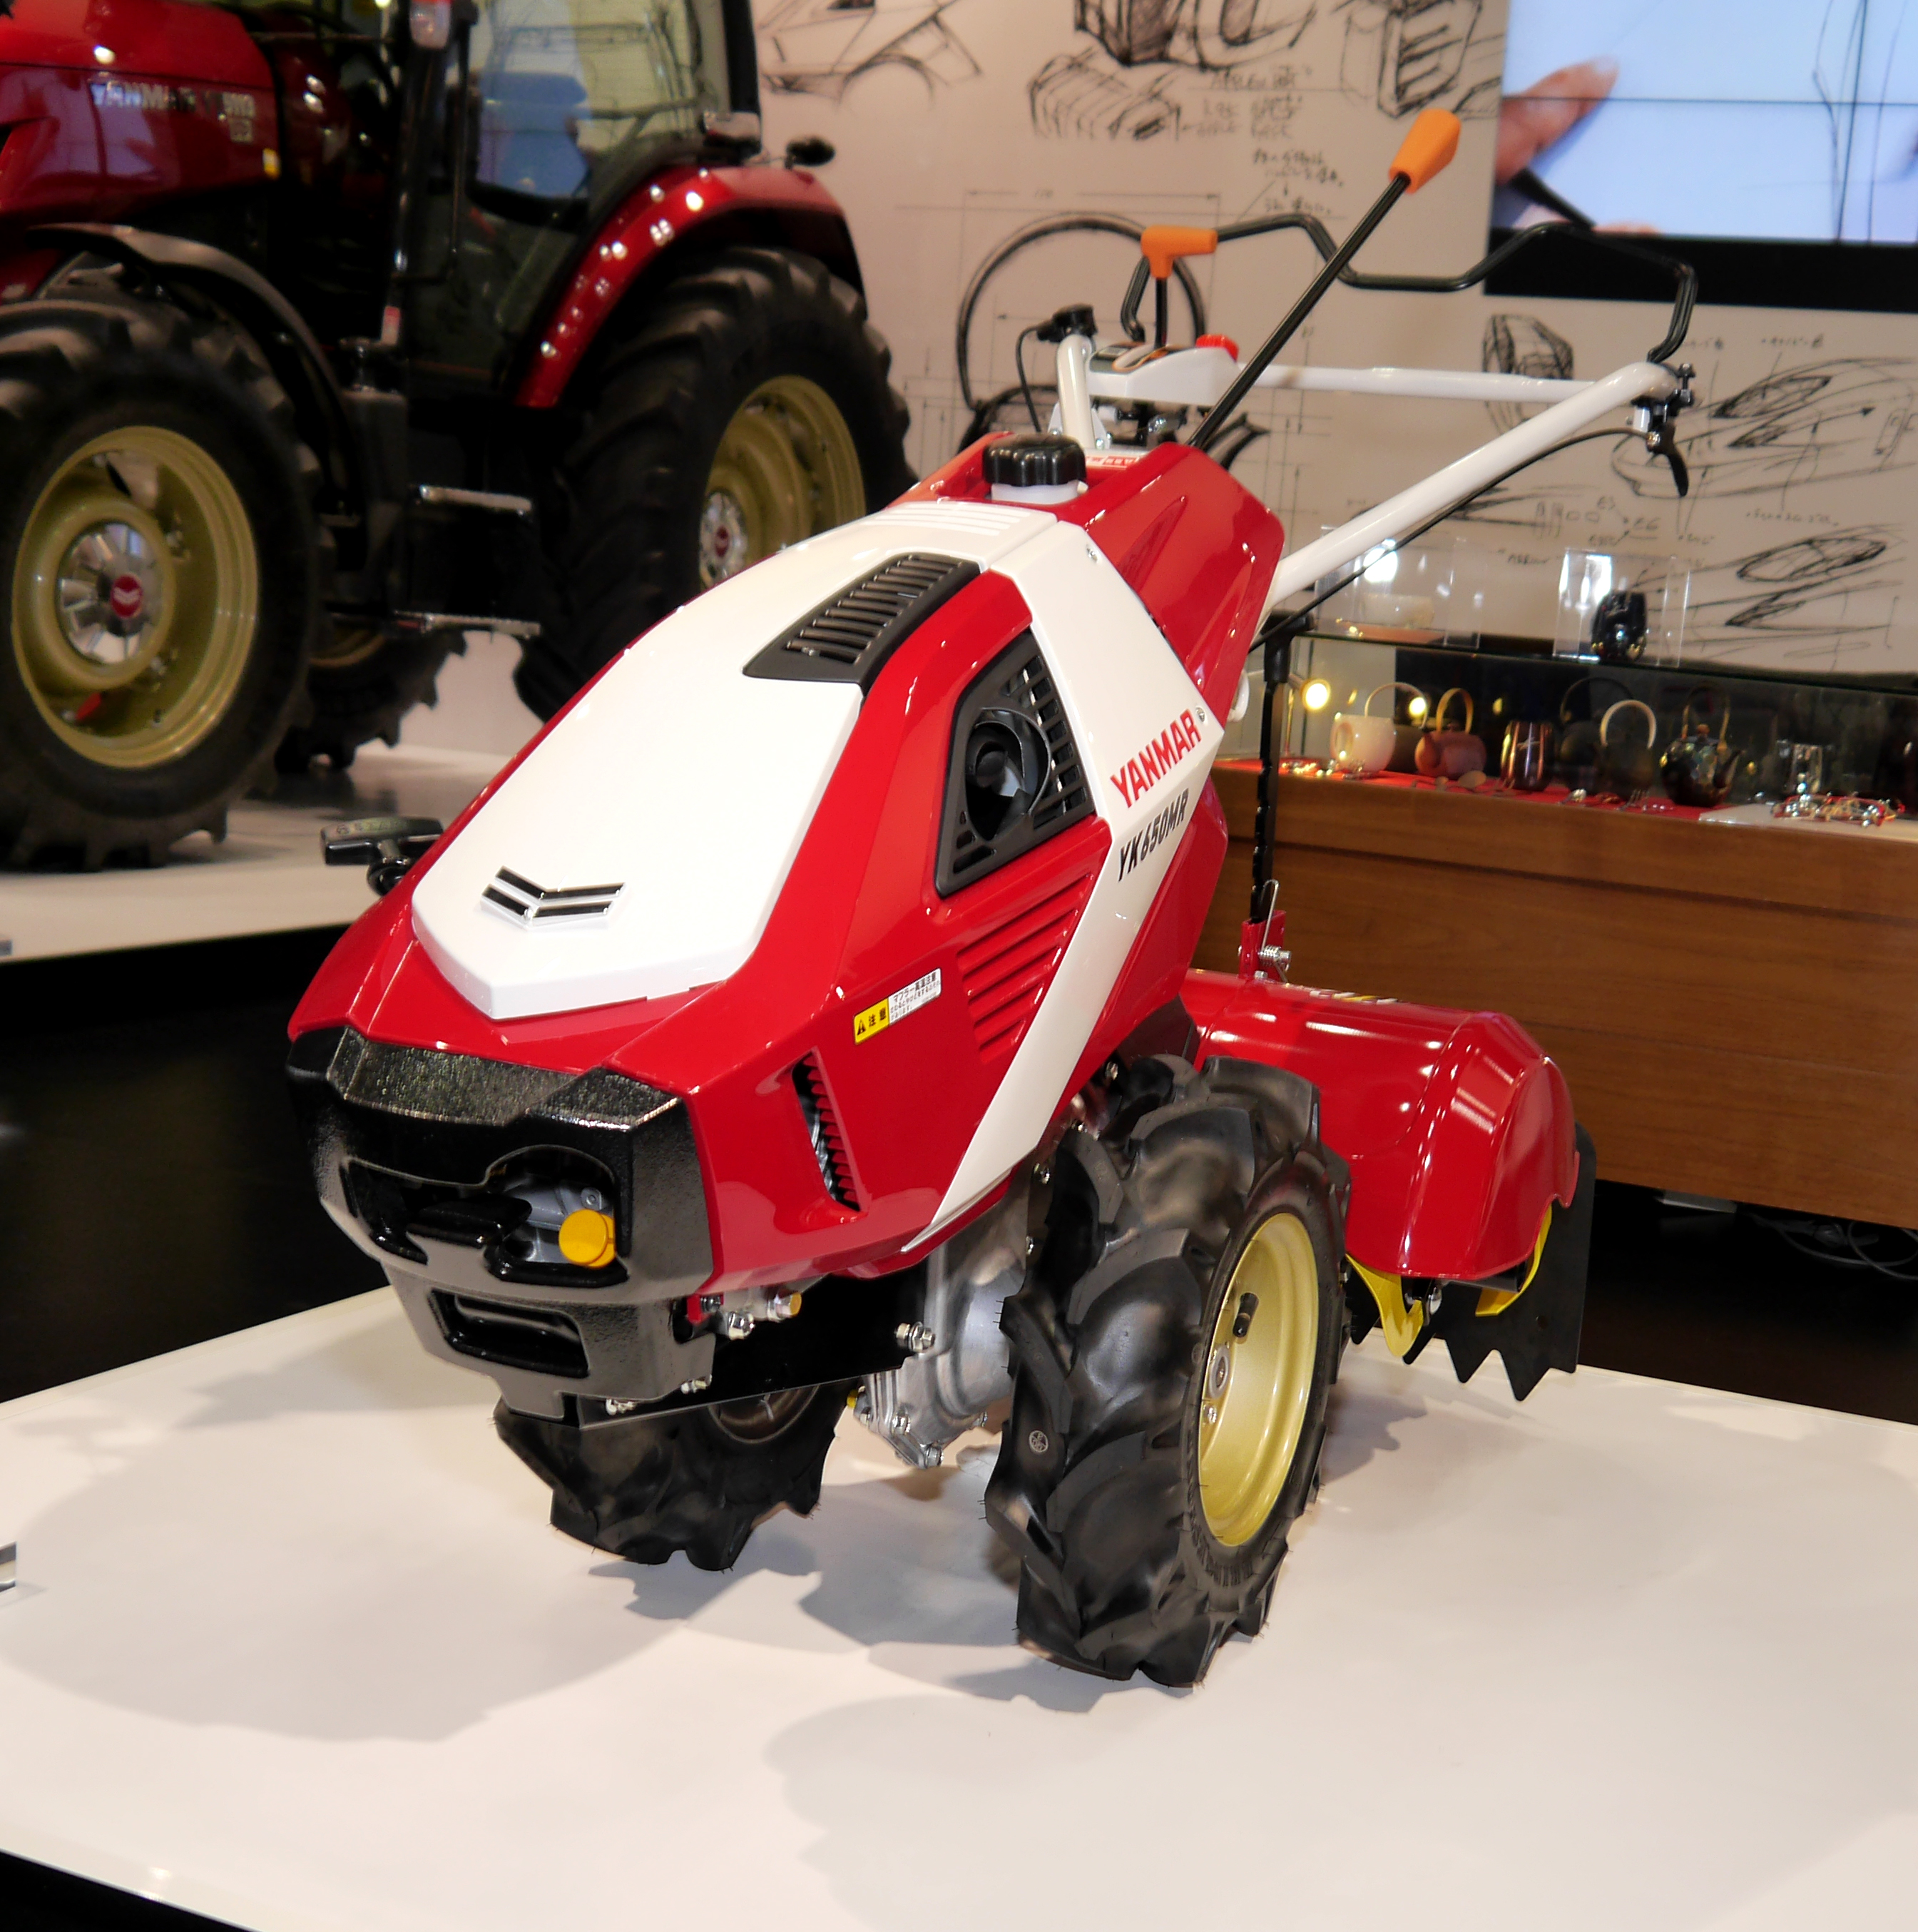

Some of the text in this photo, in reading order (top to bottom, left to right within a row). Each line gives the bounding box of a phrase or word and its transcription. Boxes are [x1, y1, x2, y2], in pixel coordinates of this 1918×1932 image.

[1110, 708, 1201, 808] YANMAR
[1118, 788, 1189, 882] YK650MR
[868, 1007, 887, 1027] 注意
